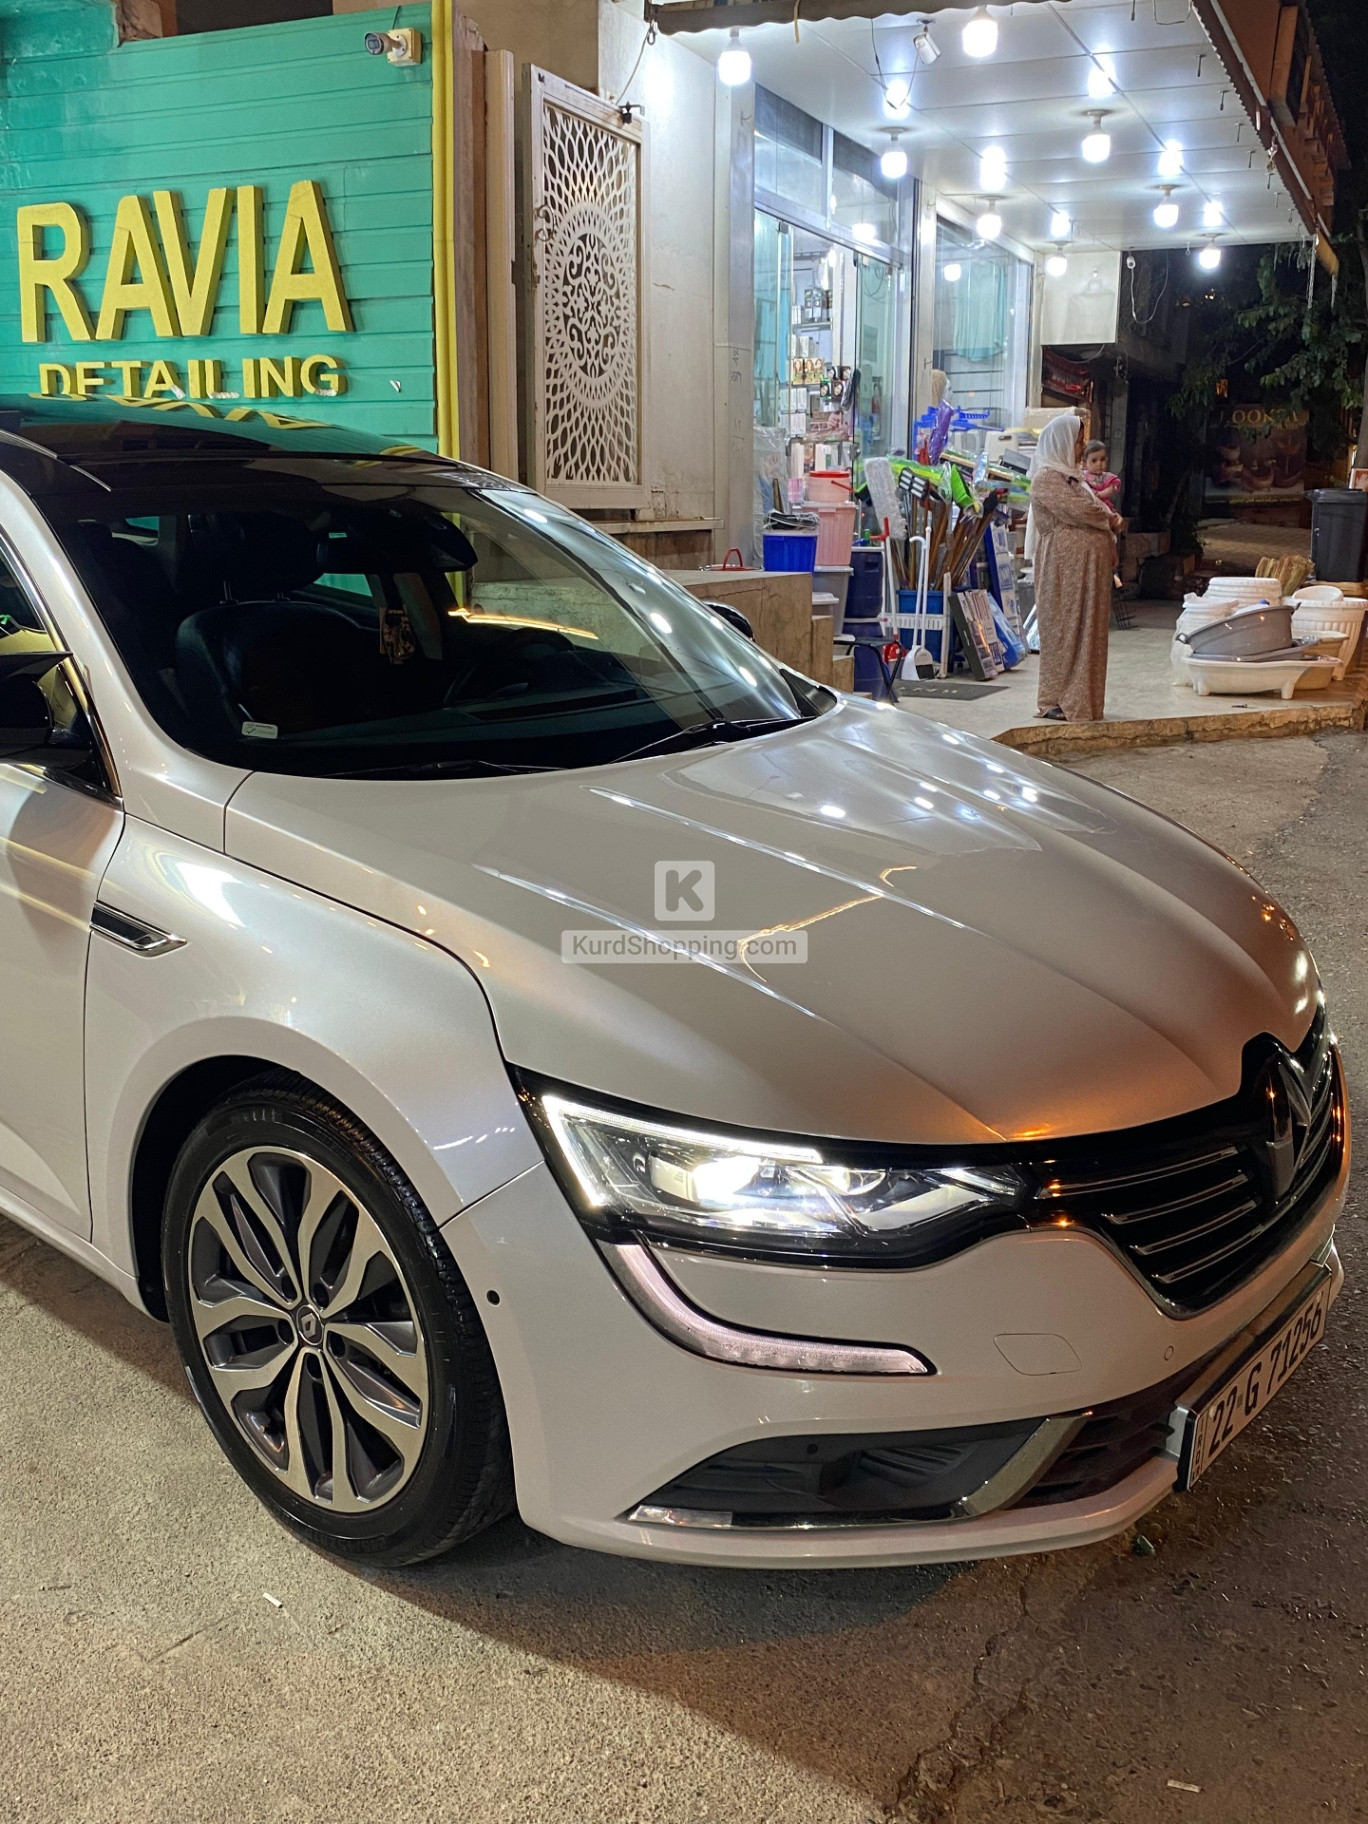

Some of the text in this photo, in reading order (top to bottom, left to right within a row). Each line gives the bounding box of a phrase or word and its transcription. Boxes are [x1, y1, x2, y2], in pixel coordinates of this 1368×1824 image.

[17, 180, 354, 342] RAVIA
[39, 355, 346, 399] DETAILING
[1208, 1291, 1324, 1458] 22 G 71256
